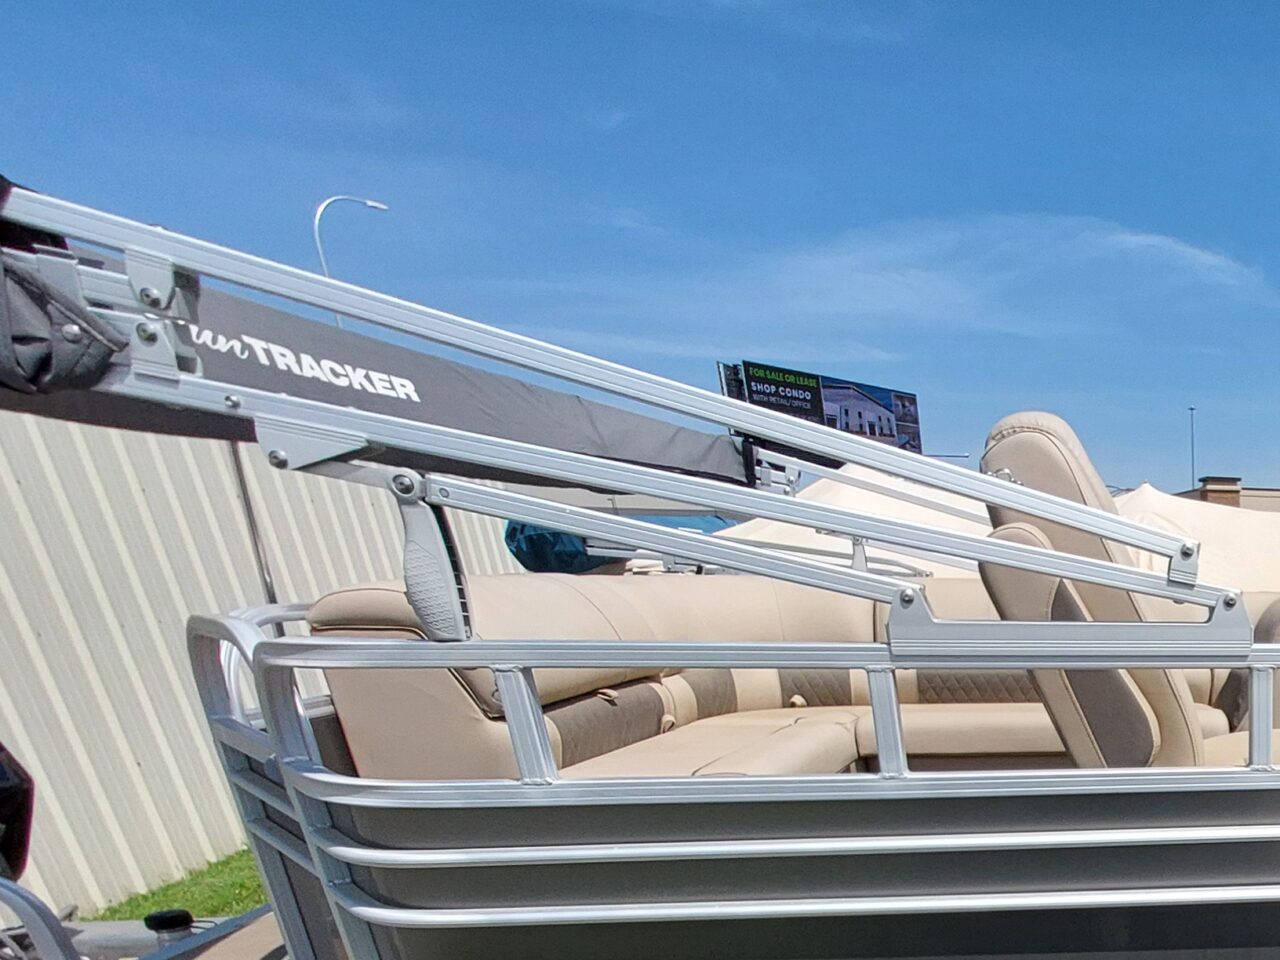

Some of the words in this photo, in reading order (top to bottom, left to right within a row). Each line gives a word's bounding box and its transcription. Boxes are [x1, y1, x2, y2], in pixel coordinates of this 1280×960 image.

[241, 334, 421, 403] TRACKER
[749, 367, 765, 377] FOR
[766, 370, 784, 382] SALE
[784, 374, 796, 384] OR
[796, 376, 817, 388] LEASE
[751, 381, 776, 394] SHOP
[778, 386, 811, 400] CONDO
